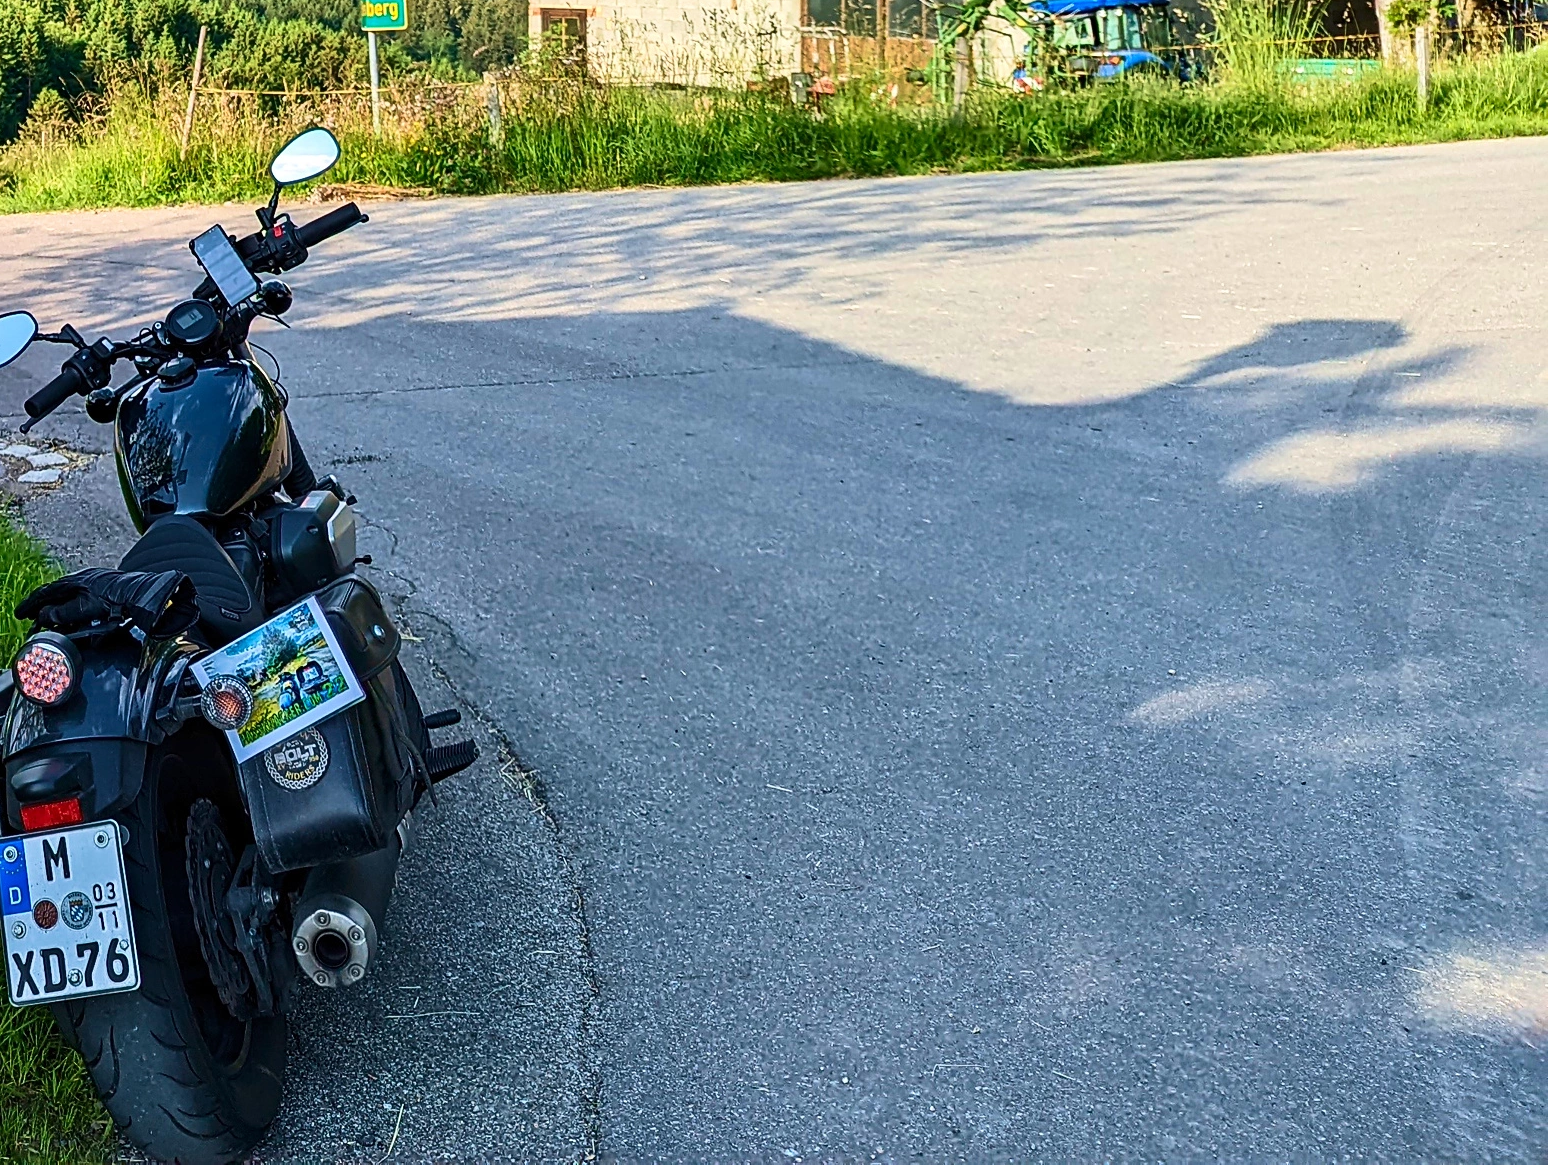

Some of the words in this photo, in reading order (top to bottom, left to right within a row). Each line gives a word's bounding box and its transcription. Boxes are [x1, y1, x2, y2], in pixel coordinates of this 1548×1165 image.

[274, 743, 316, 765] BOLT
[285, 765, 315, 780] RIDERS
[42, 836, 71, 881] M
[8, 886, 22, 905] D
[92, 882, 116, 902] 03
[97, 910, 119, 930] 11
